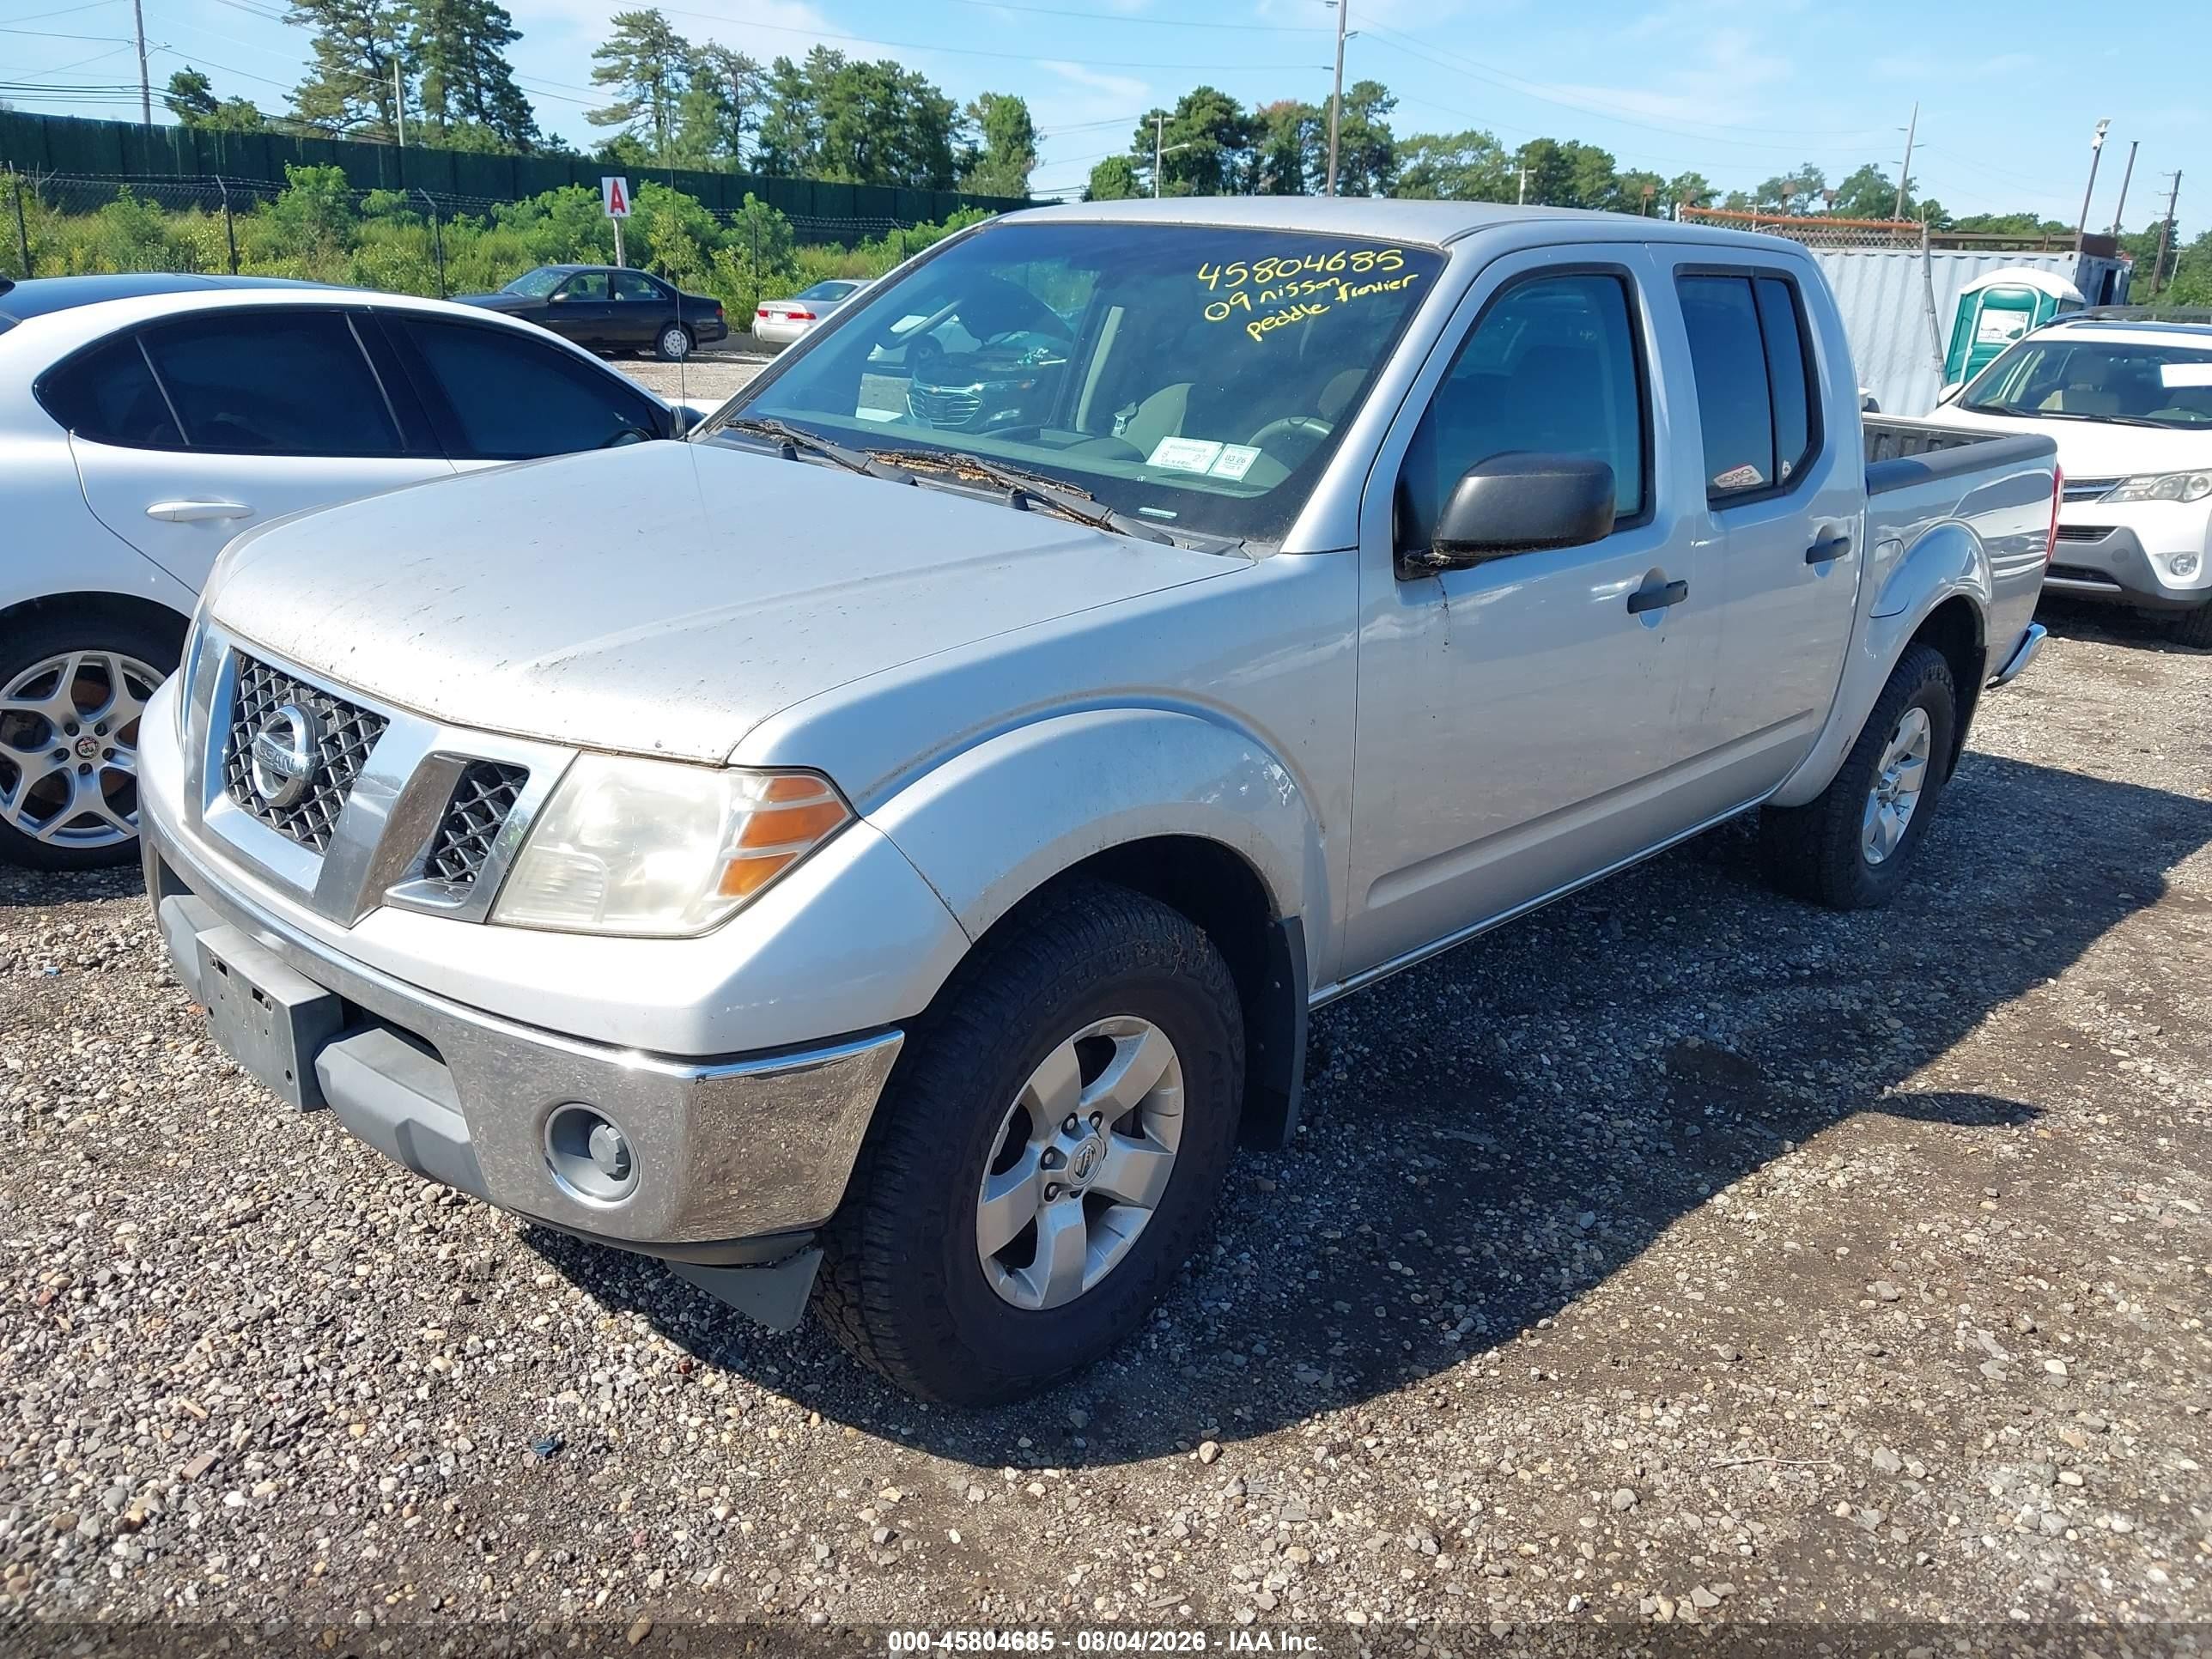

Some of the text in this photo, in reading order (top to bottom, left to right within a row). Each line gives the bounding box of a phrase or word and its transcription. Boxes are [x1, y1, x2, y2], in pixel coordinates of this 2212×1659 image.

[611, 179, 626, 213] A
[1197, 250, 1405, 290] 45804685
[1204, 291, 1251, 320] 09
[1247, 303, 1331, 342] peddle
